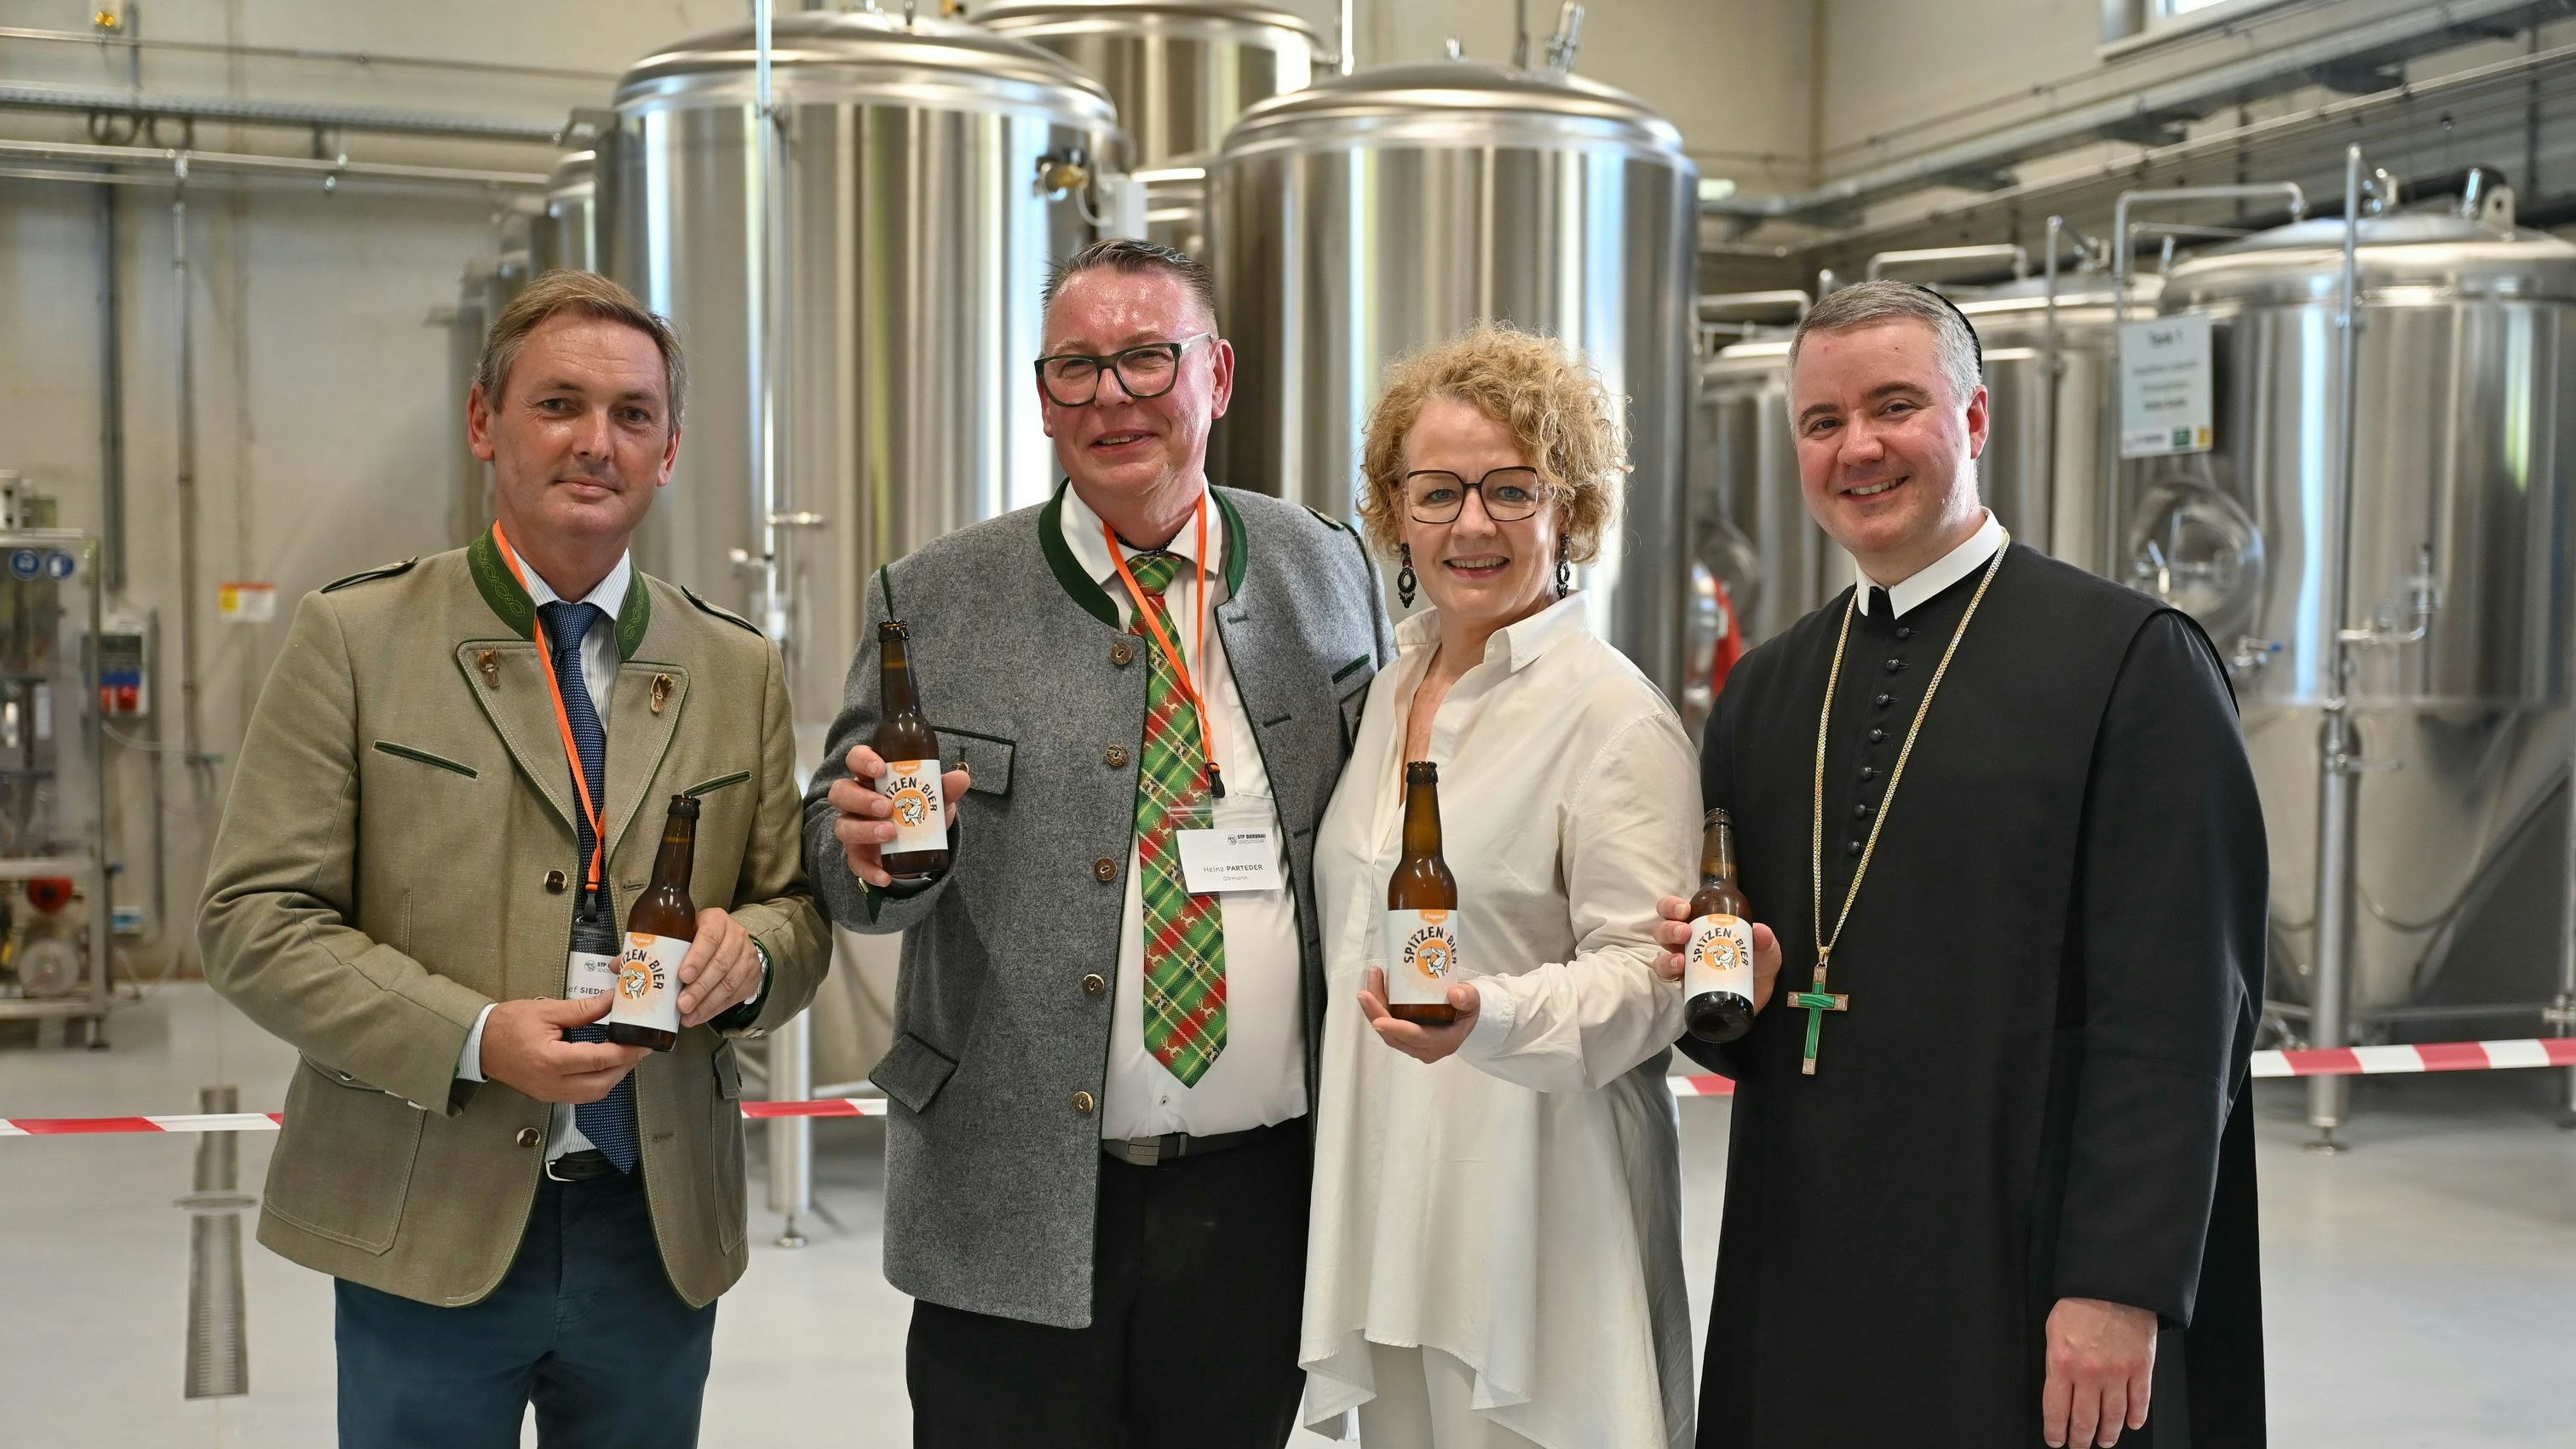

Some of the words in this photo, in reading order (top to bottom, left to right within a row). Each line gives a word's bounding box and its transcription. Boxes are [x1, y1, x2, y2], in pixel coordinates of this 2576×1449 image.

[885, 777, 917, 800] ITZEN
[921, 784, 937, 811] BIER
[1404, 926, 1444, 963] SPITZEN
[1446, 935, 1458, 964] BIER
[1693, 928, 1732, 963] SPITZEN
[1735, 939, 1749, 966] BIER
[648, 959, 665, 990] BIER
